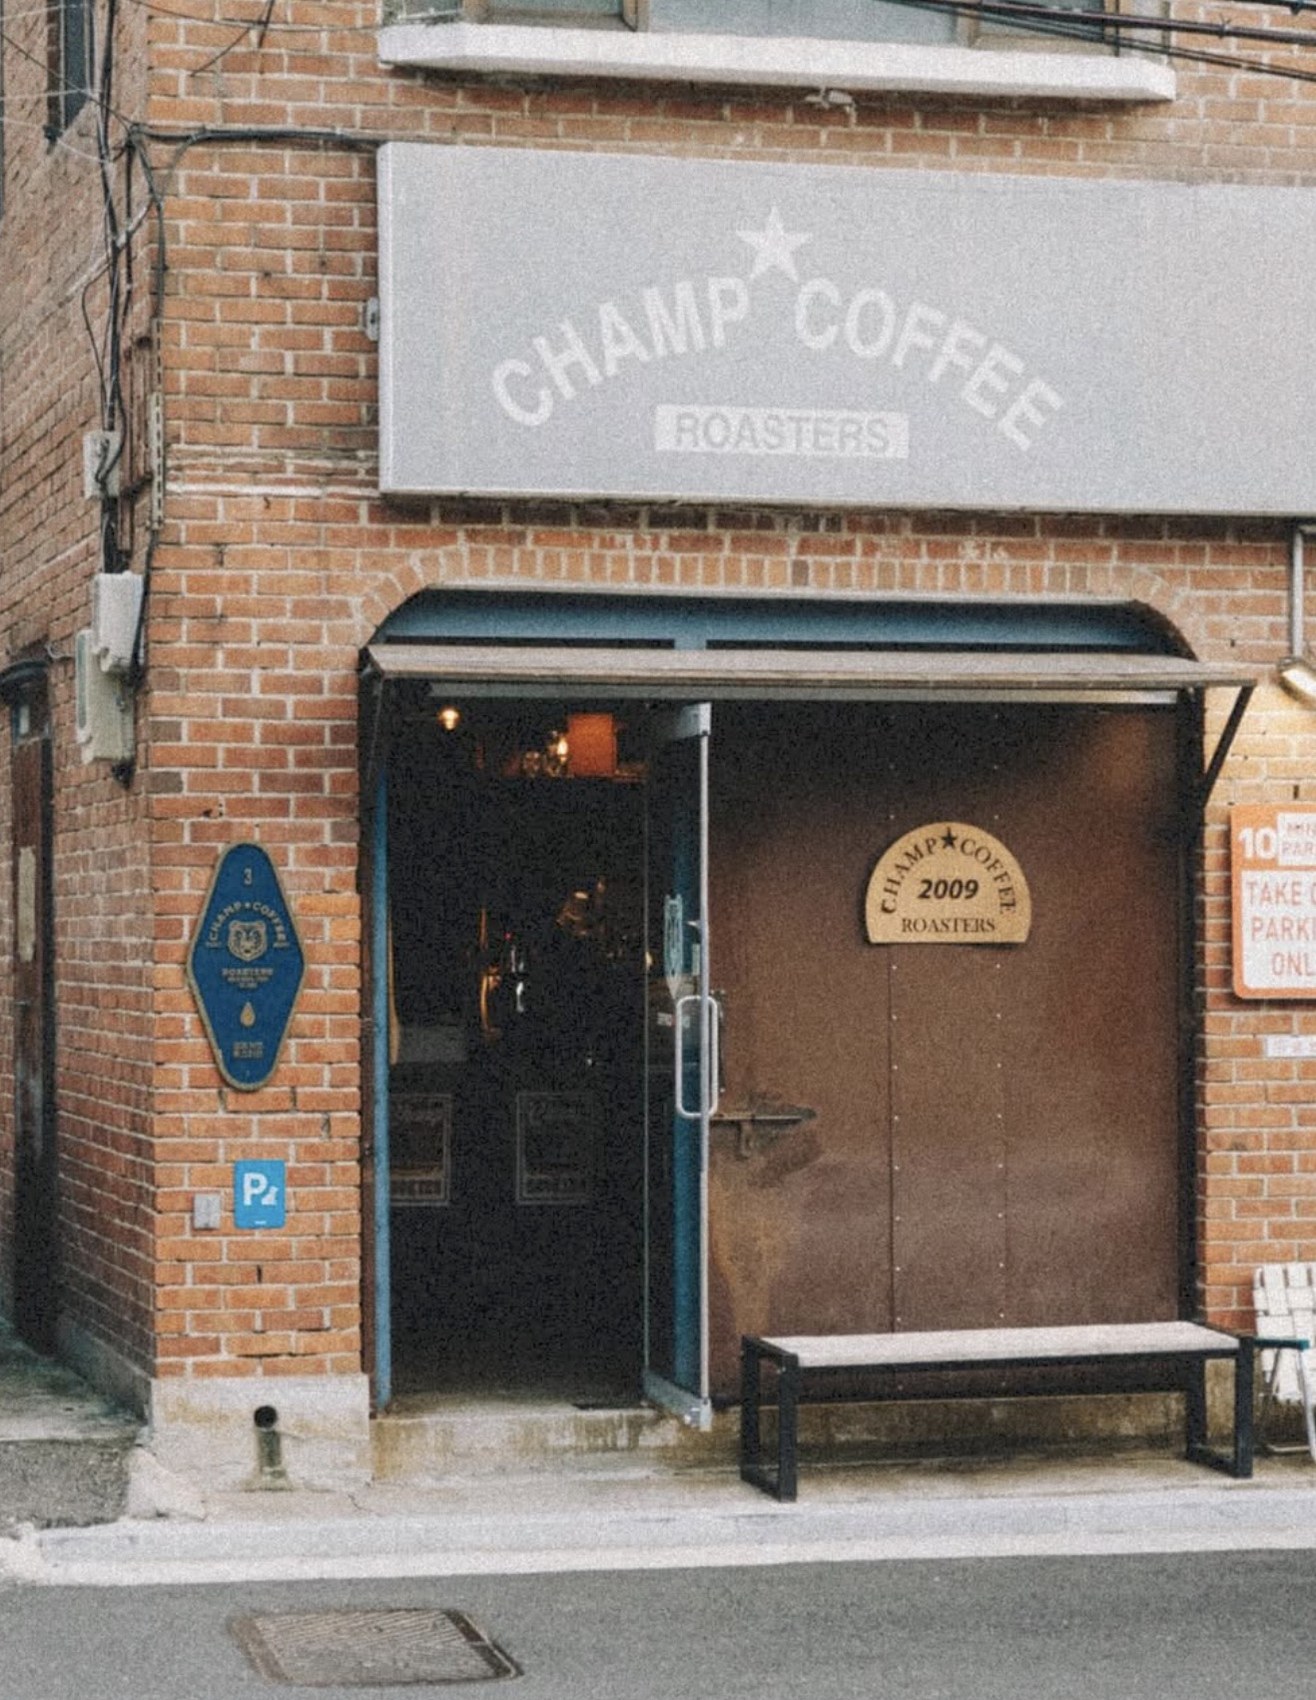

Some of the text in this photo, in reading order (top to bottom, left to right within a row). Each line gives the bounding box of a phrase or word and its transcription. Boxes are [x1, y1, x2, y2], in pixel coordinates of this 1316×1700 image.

[492, 277, 1064, 451] CHAMP COFFEE
[675, 412, 890, 451] ROASTERS
[1238, 827, 1277, 859] 10
[244, 868, 253, 885] 3
[880, 838, 1017, 915] CHAMP COFFEE
[917, 879, 979, 900] 2009
[1246, 881, 1302, 906] TAKE
[209, 901, 287, 940] CHAMP COFFEE
[902, 918, 995, 932] ROASTERS
[1272, 951, 1316, 976] ONL
